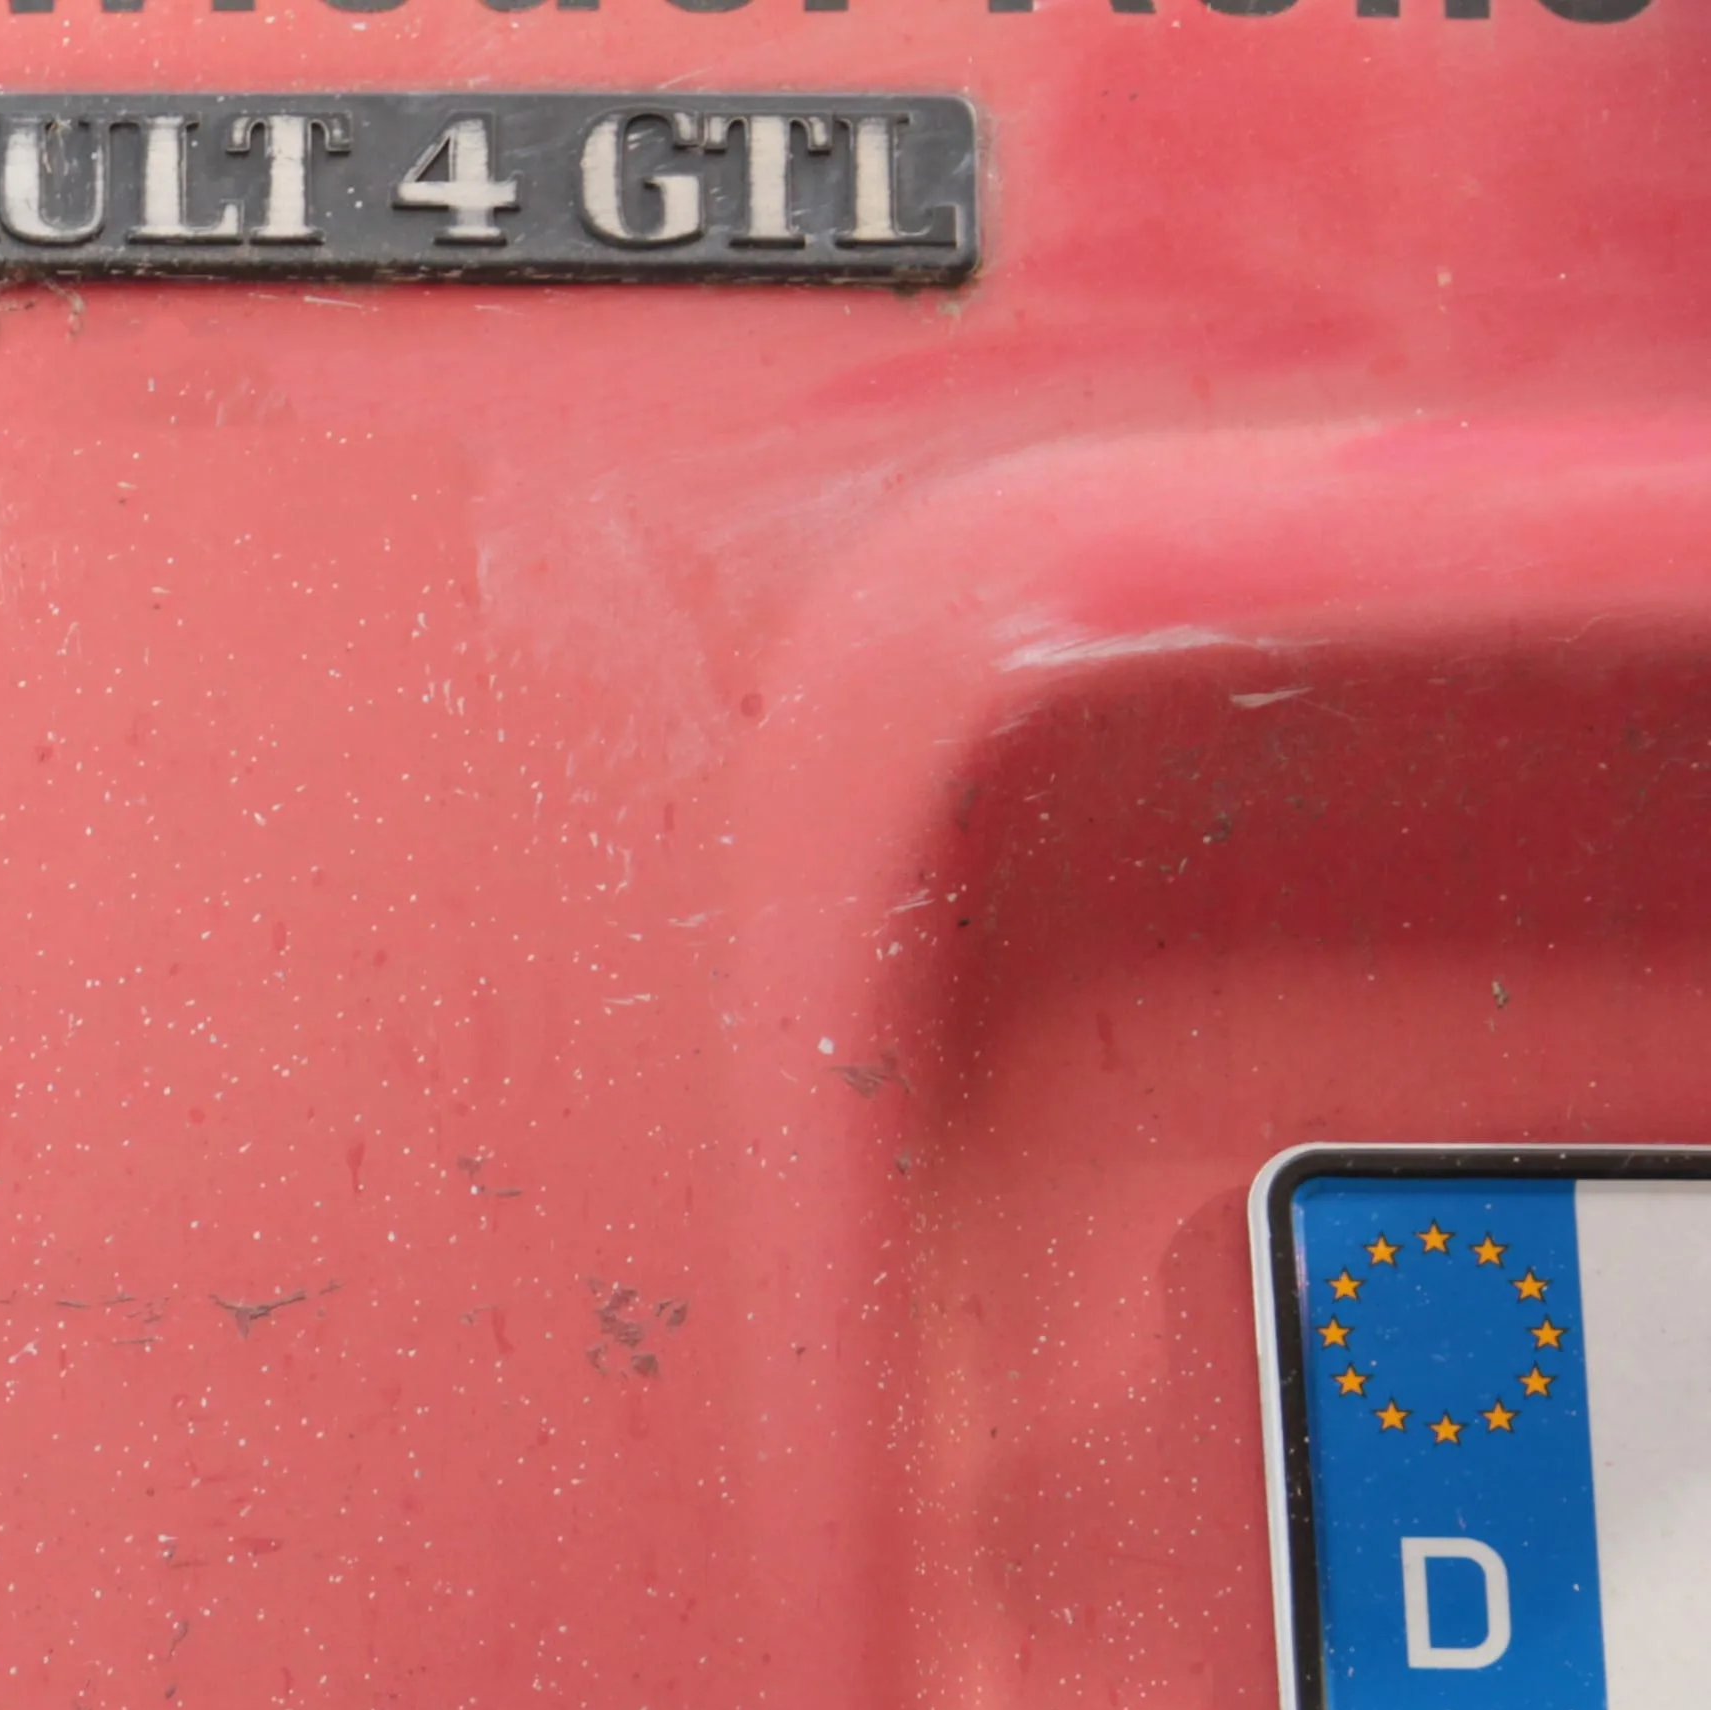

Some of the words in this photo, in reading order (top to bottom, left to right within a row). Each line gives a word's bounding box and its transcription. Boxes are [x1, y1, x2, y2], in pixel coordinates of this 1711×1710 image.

[390, 109, 521, 246] 4
[580, 104, 960, 250] GTL
[1401, 1537, 1510, 1670] D
